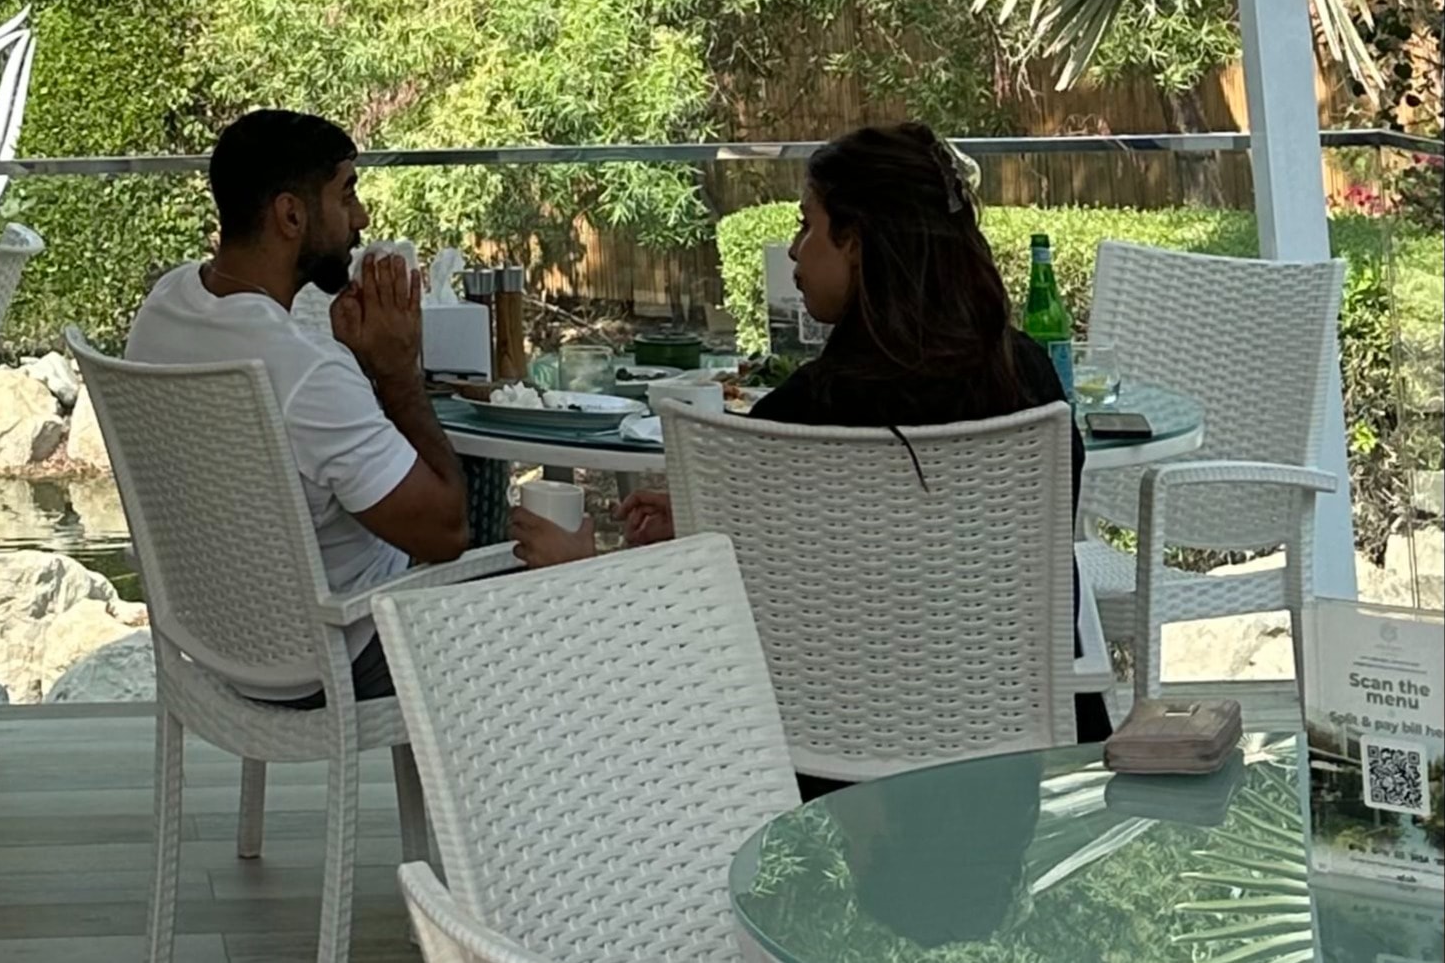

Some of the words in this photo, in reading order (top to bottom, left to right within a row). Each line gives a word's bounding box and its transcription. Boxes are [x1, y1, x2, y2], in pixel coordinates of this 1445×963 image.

[1349, 672, 1393, 692] Scan
[1398, 679, 1431, 697] the
[1366, 691, 1420, 710] menu
[1361, 715, 1371, 728] &
[1374, 719, 1399, 734] pay
[1402, 720, 1423, 735] bill
